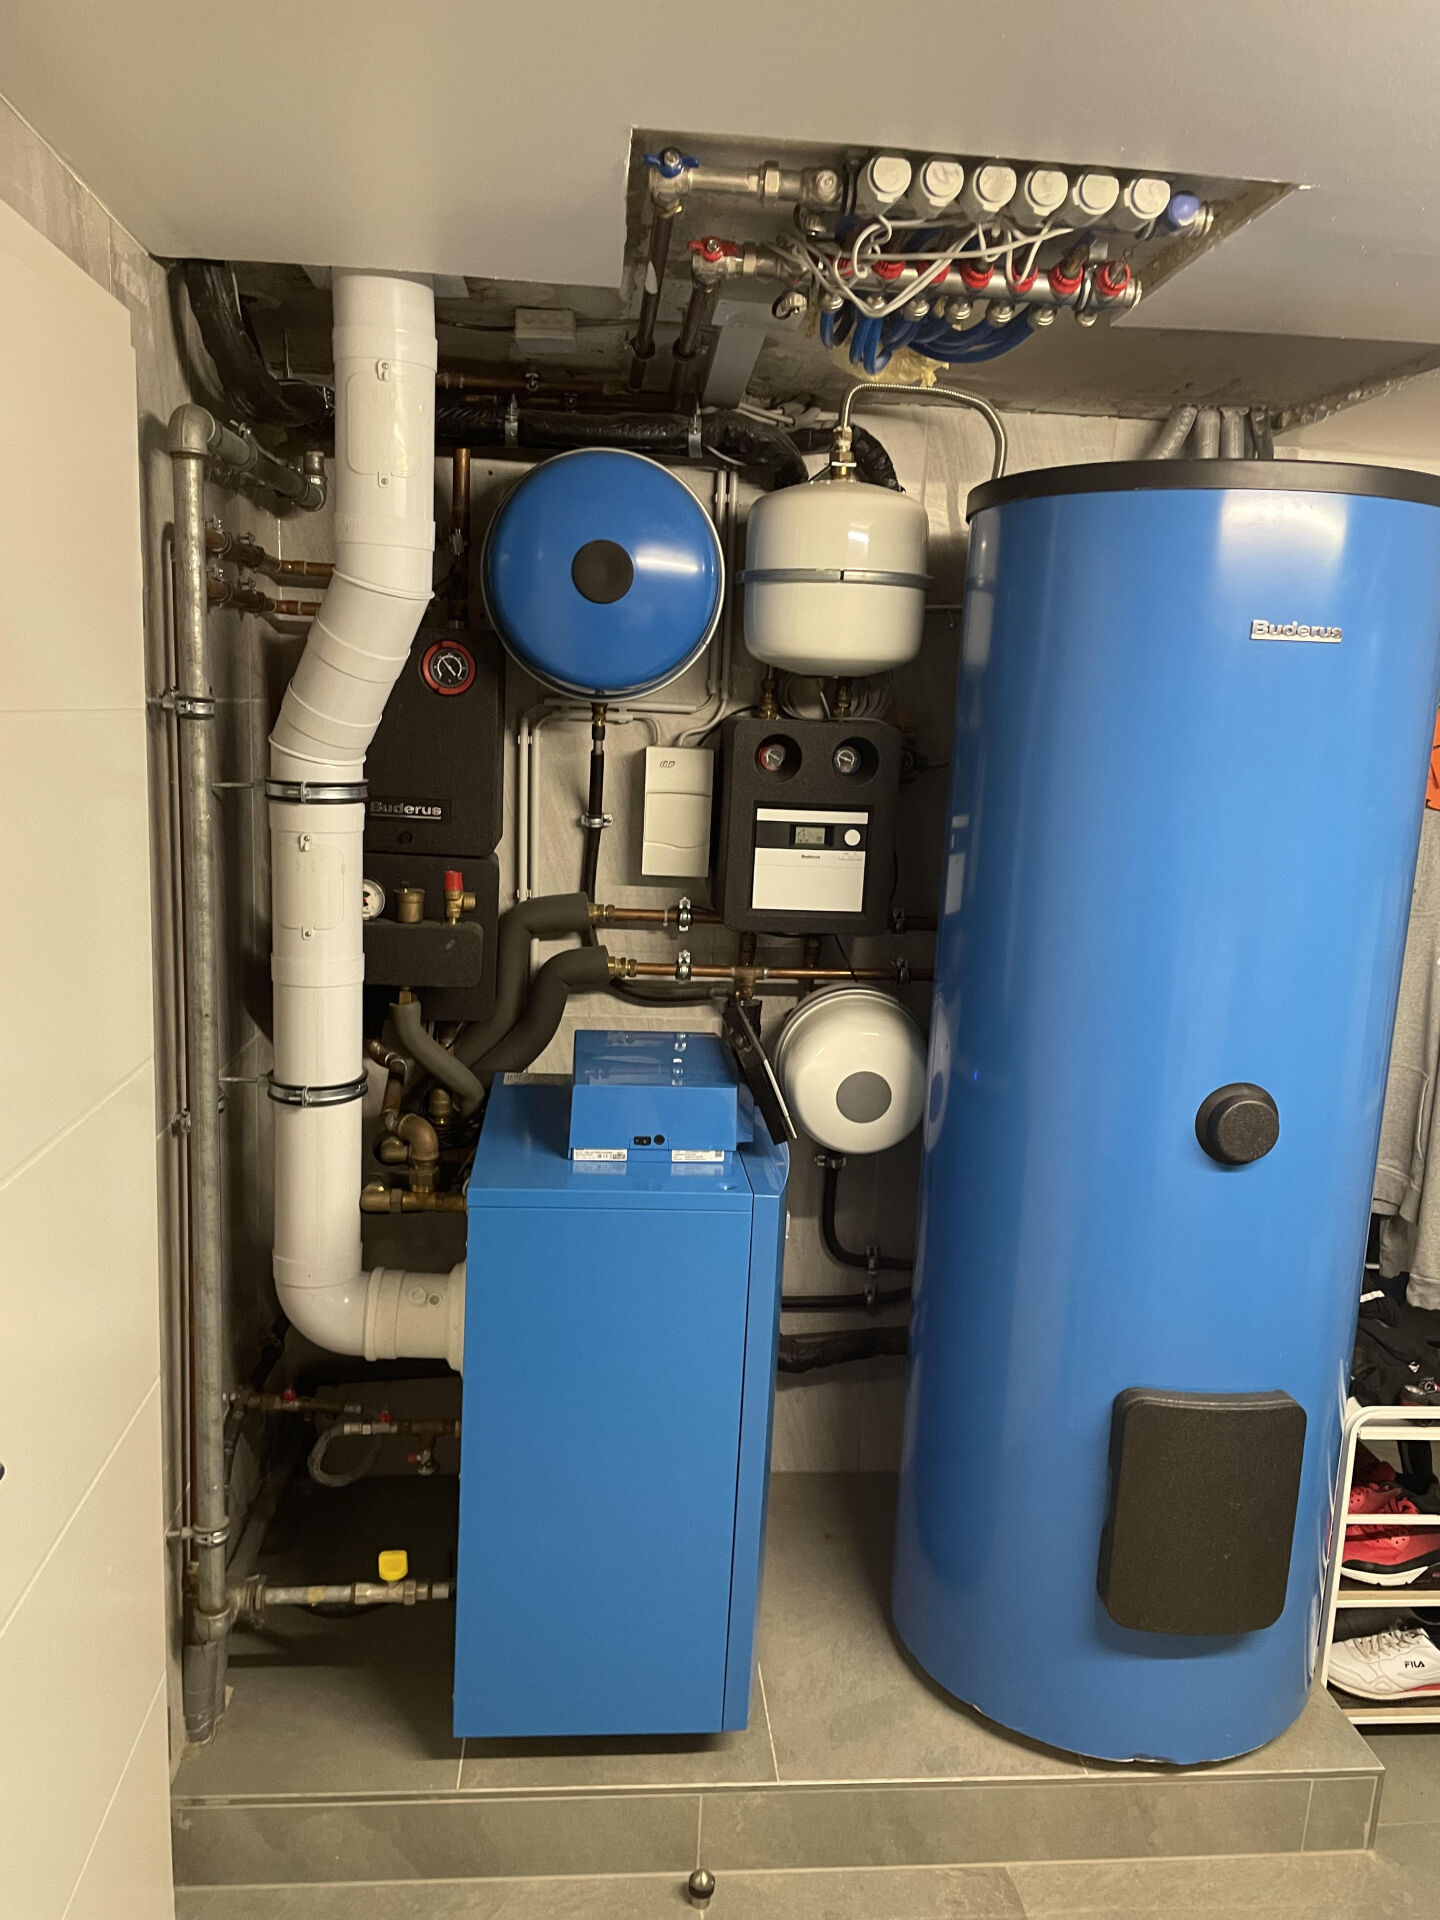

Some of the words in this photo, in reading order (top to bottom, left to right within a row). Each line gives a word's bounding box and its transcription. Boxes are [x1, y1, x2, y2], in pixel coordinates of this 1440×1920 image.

[1251, 618, 1343, 640] Buderus
[369, 801, 442, 816] Buderus
[1404, 1660, 1426, 1669] FILA
